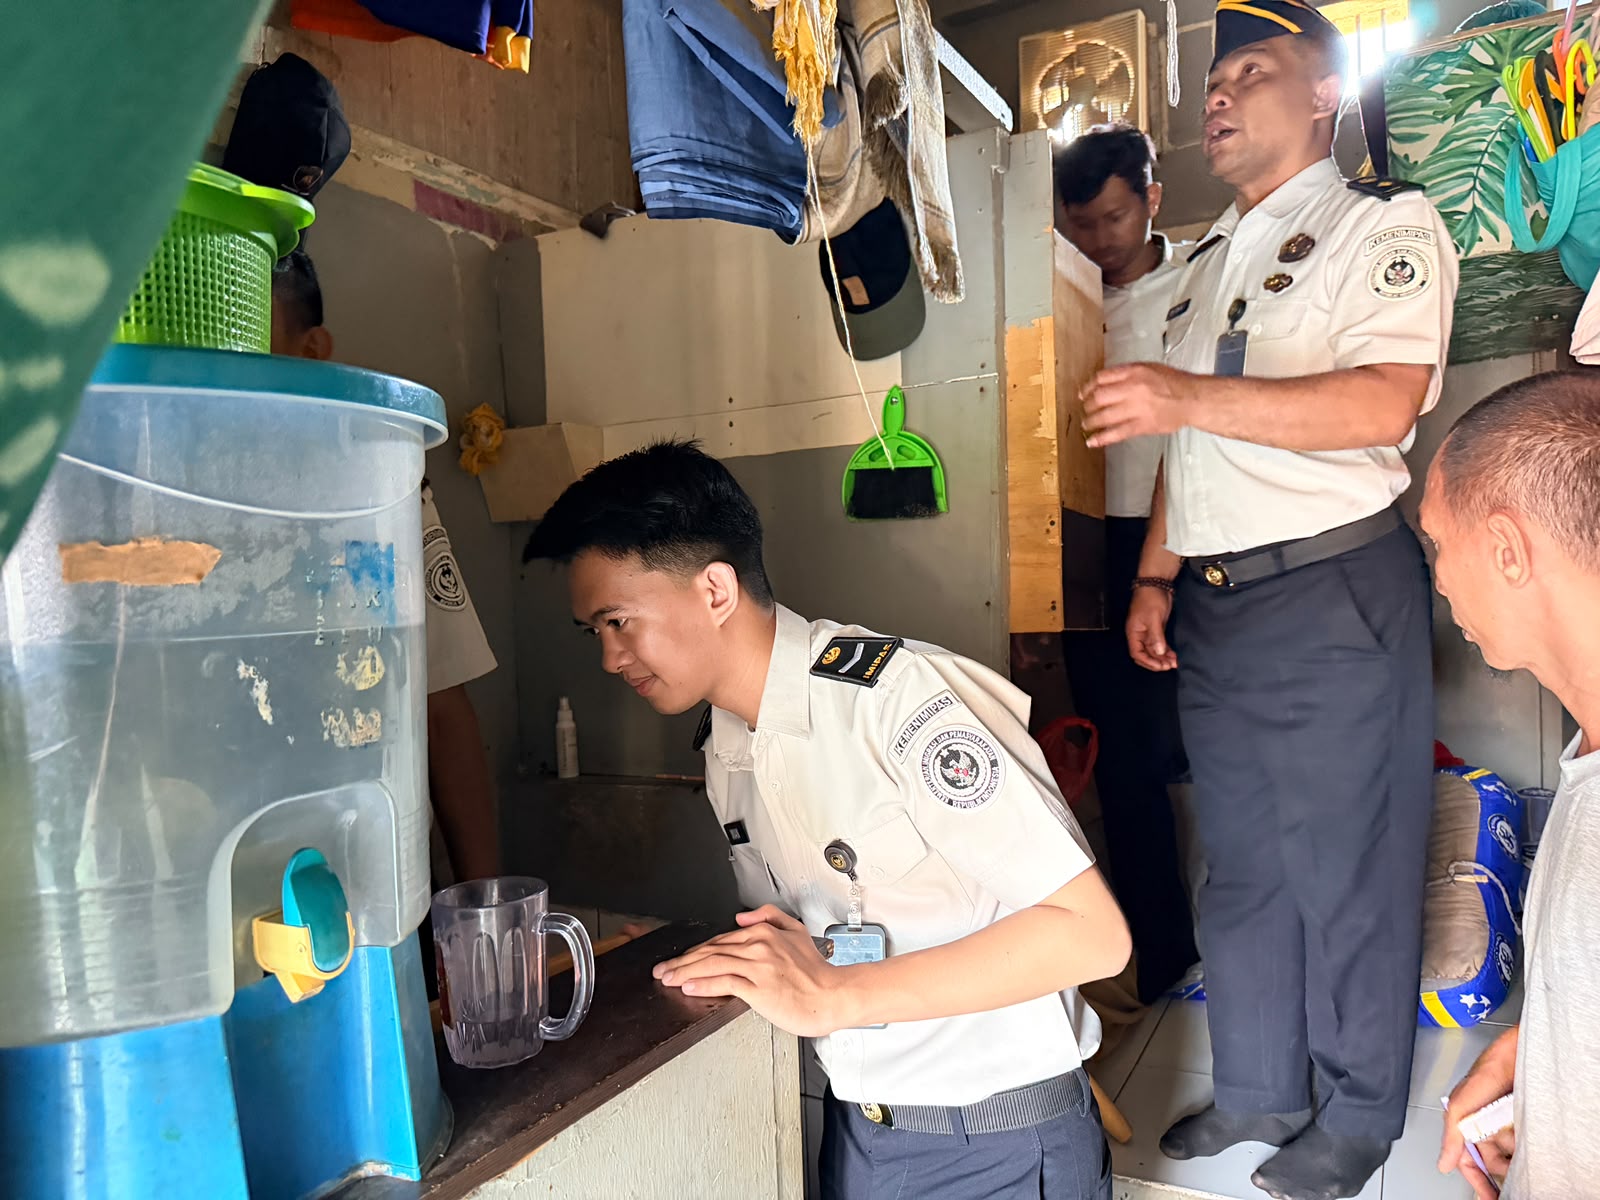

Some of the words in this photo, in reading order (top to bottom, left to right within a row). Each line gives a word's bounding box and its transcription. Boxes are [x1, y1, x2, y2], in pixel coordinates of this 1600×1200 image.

[1369, 229, 1431, 250] KEMENIMIPAS
[863, 643, 892, 679] IMIPAS
[893, 696, 953, 756] KEMENIMIPAS
